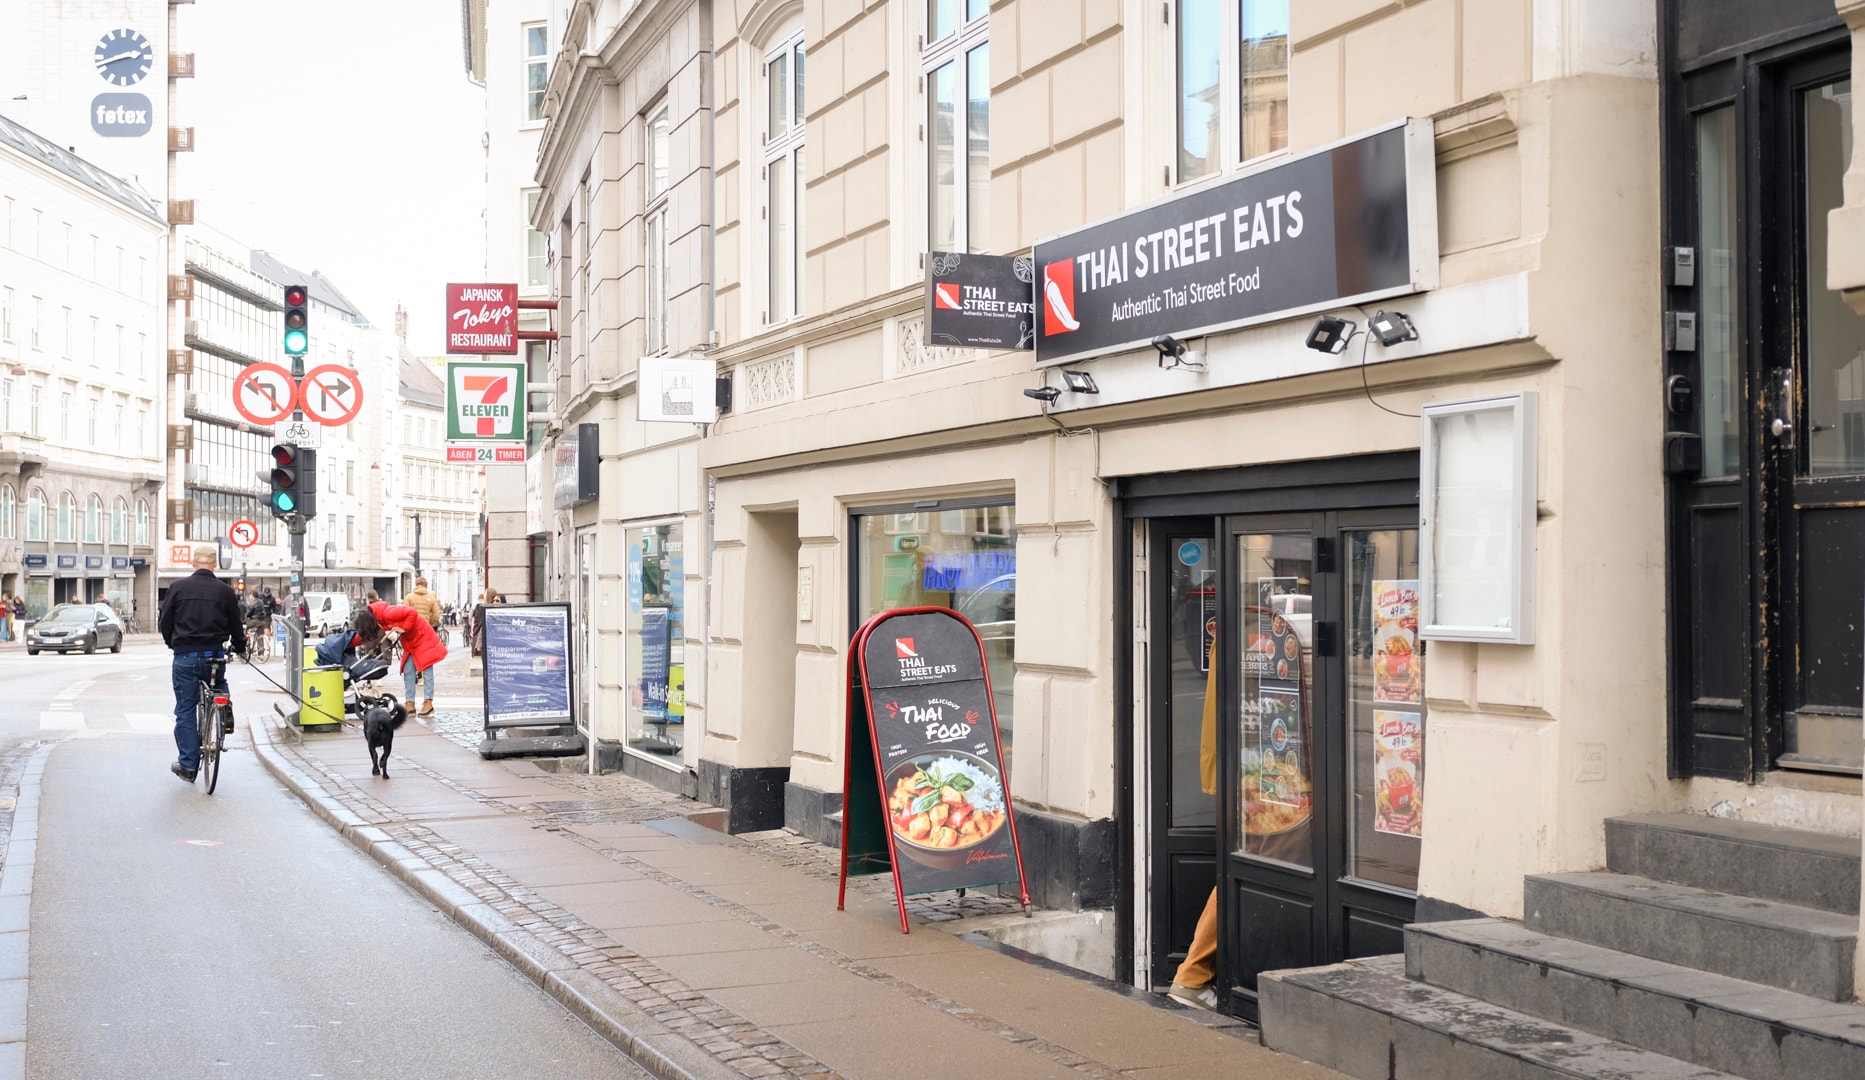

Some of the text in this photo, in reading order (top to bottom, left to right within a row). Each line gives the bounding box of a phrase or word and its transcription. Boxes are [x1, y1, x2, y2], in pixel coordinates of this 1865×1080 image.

[1076, 189, 1305, 293] THAI STREET EATS
[460, 288, 503, 302] JAPANSK
[963, 285, 997, 300] THAI
[1111, 266, 1261, 323] Authentic Thai Street Food
[963, 299, 1034, 314] STREET EATS
[453, 303, 513, 330] Tokyo
[451, 333, 513, 347] RESTAURANT
[450, 448, 523, 461] ÅBEN 24 TIMER
[898, 656, 925, 669] THAI
[900, 664, 957, 678] STREET EATS
[927, 698, 961, 711] DELICIOUS
[899, 705, 943, 724] THAI
[925, 722, 972, 740] FOOD
[1392, 736, 1401, 748] 49
[888, 748, 908, 758] PROTEIN
